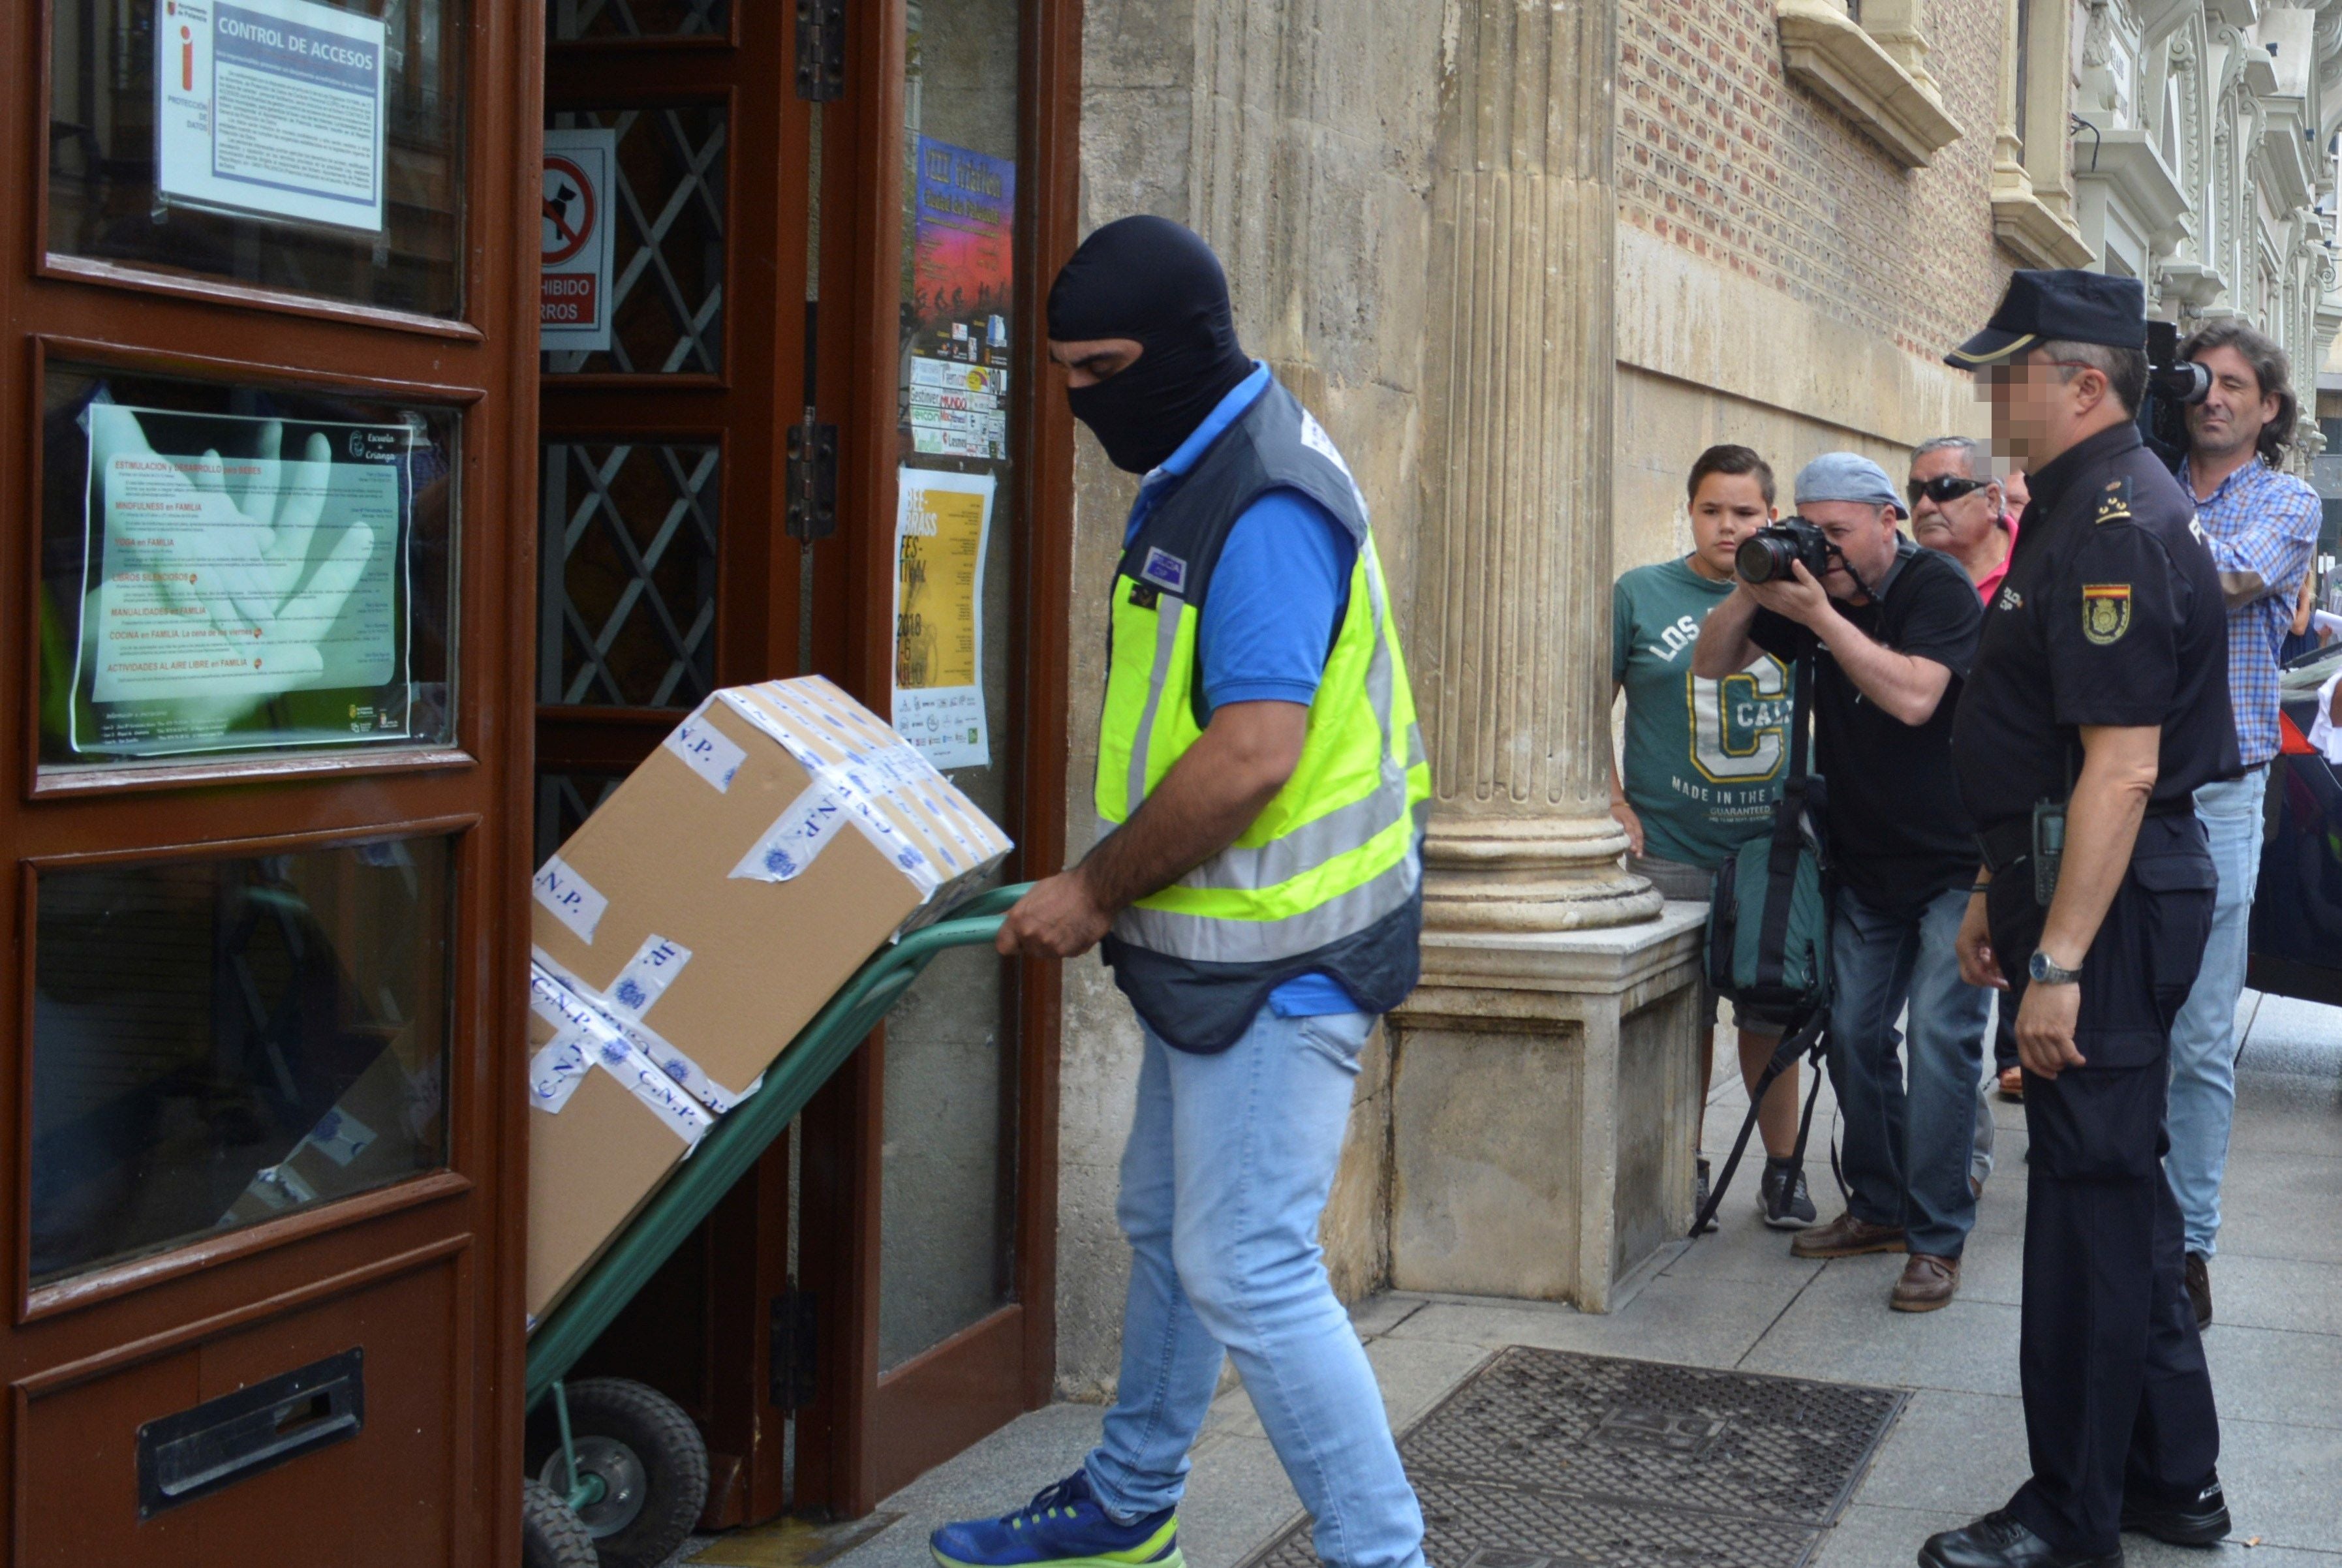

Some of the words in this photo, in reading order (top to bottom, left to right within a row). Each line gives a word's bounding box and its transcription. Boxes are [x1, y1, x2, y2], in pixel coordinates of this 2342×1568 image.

[219, 17, 285, 48] CONTROL
[289, 35, 307, 54] DE
[311, 42, 373, 70] ACCESOS
[187, 120, 208, 131] DATOS
[116, 502, 164, 511] MINDFULNESS
[175, 502, 202, 511] FAMILIA
[115, 538, 136, 546] YOGA
[147, 538, 174, 547] FAMILIA
[112, 573, 140, 582] LIBROS
[142, 573, 189, 581] SILENCIOSOS
[111, 607, 168, 617] MANUALIDADES
[897, 613, 922, 637] 2018
[110, 630, 140, 640] COCINA
[1648, 615, 1701, 662] LOS
[108, 663, 158, 673] ACTIVIDADES
[170, 661, 187, 670] AIRE
[189, 660, 209, 669] LIBRE
[1672, 775, 1708, 802] MADE
[1717, 791, 1732, 805] IN
[1740, 789, 1766, 804] THE
[1710, 805, 1771, 816] GUARANTEED
